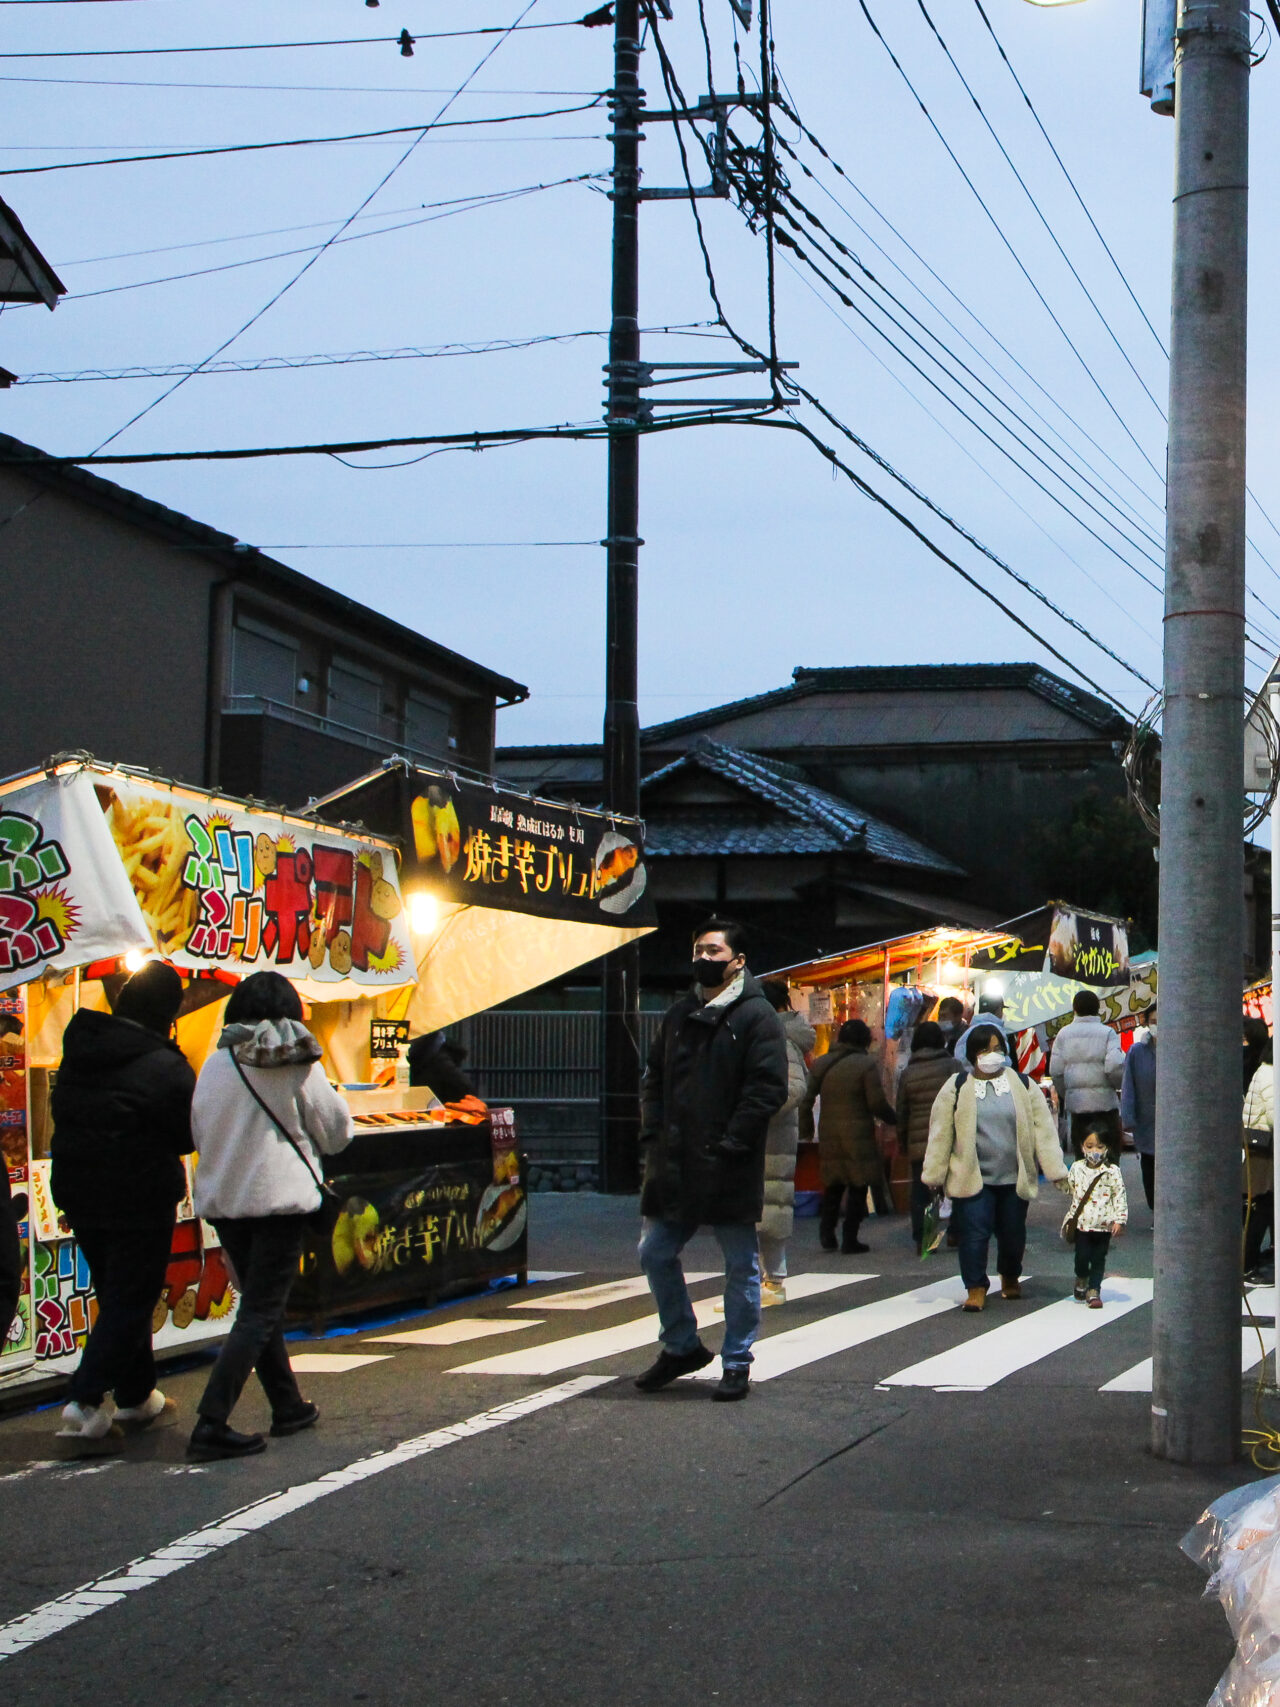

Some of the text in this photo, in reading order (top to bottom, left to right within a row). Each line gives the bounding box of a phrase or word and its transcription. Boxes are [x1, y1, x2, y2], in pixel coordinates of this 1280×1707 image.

[263, 842, 393, 973] ポテト
[463, 825, 602, 900] 焼き芋ブリュレ
